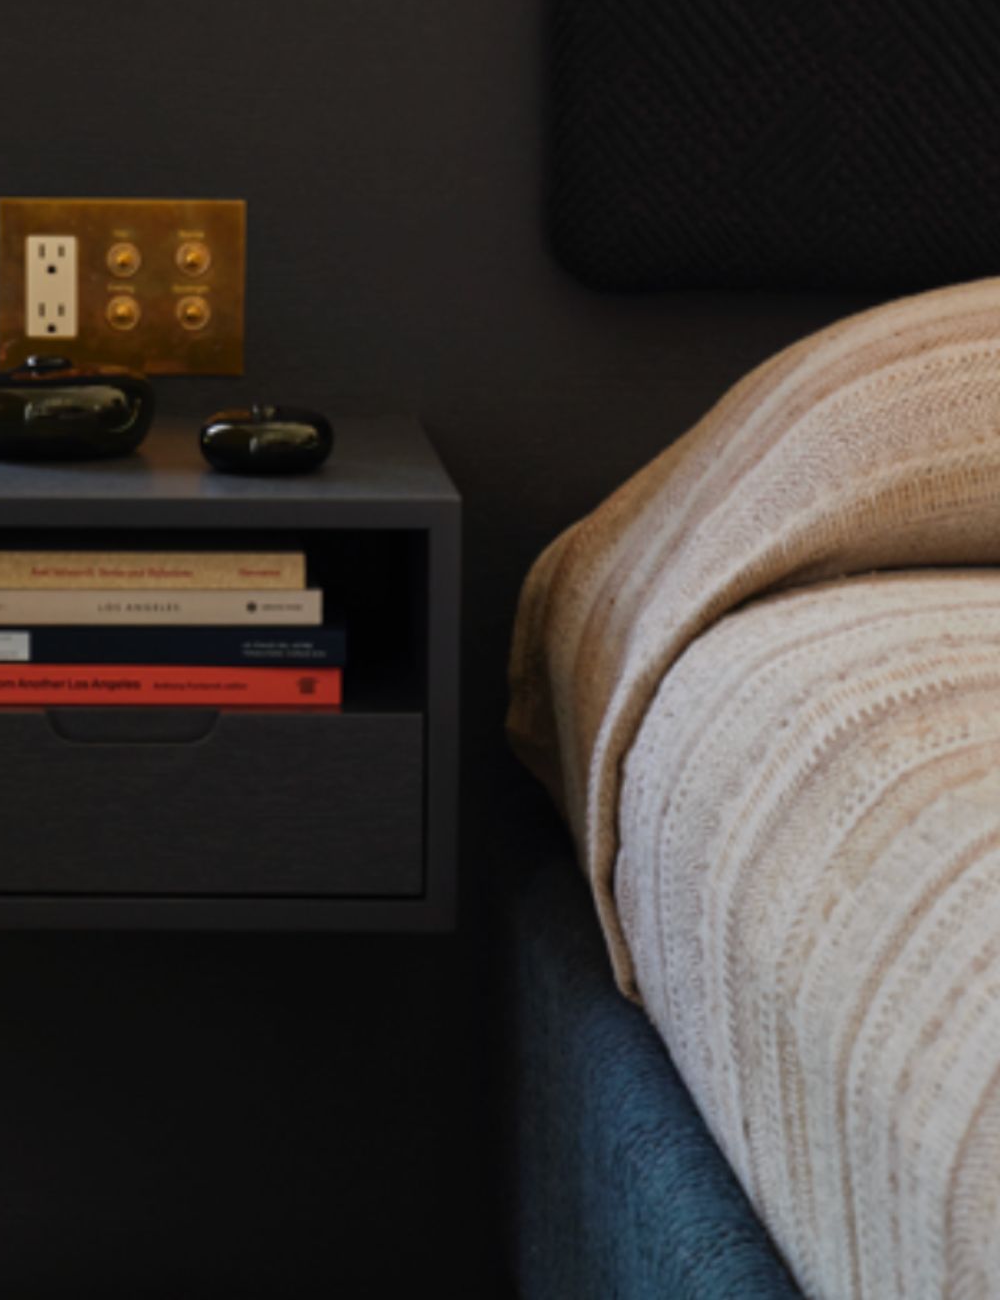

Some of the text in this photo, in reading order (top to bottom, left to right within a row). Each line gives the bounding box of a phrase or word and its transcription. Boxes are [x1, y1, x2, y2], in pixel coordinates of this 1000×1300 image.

[97, 603, 180, 612] LOS ANGELES
[17, 677, 65, 689] Another
[67, 678, 89, 689] Los
[91, 678, 142, 691] Angeles
